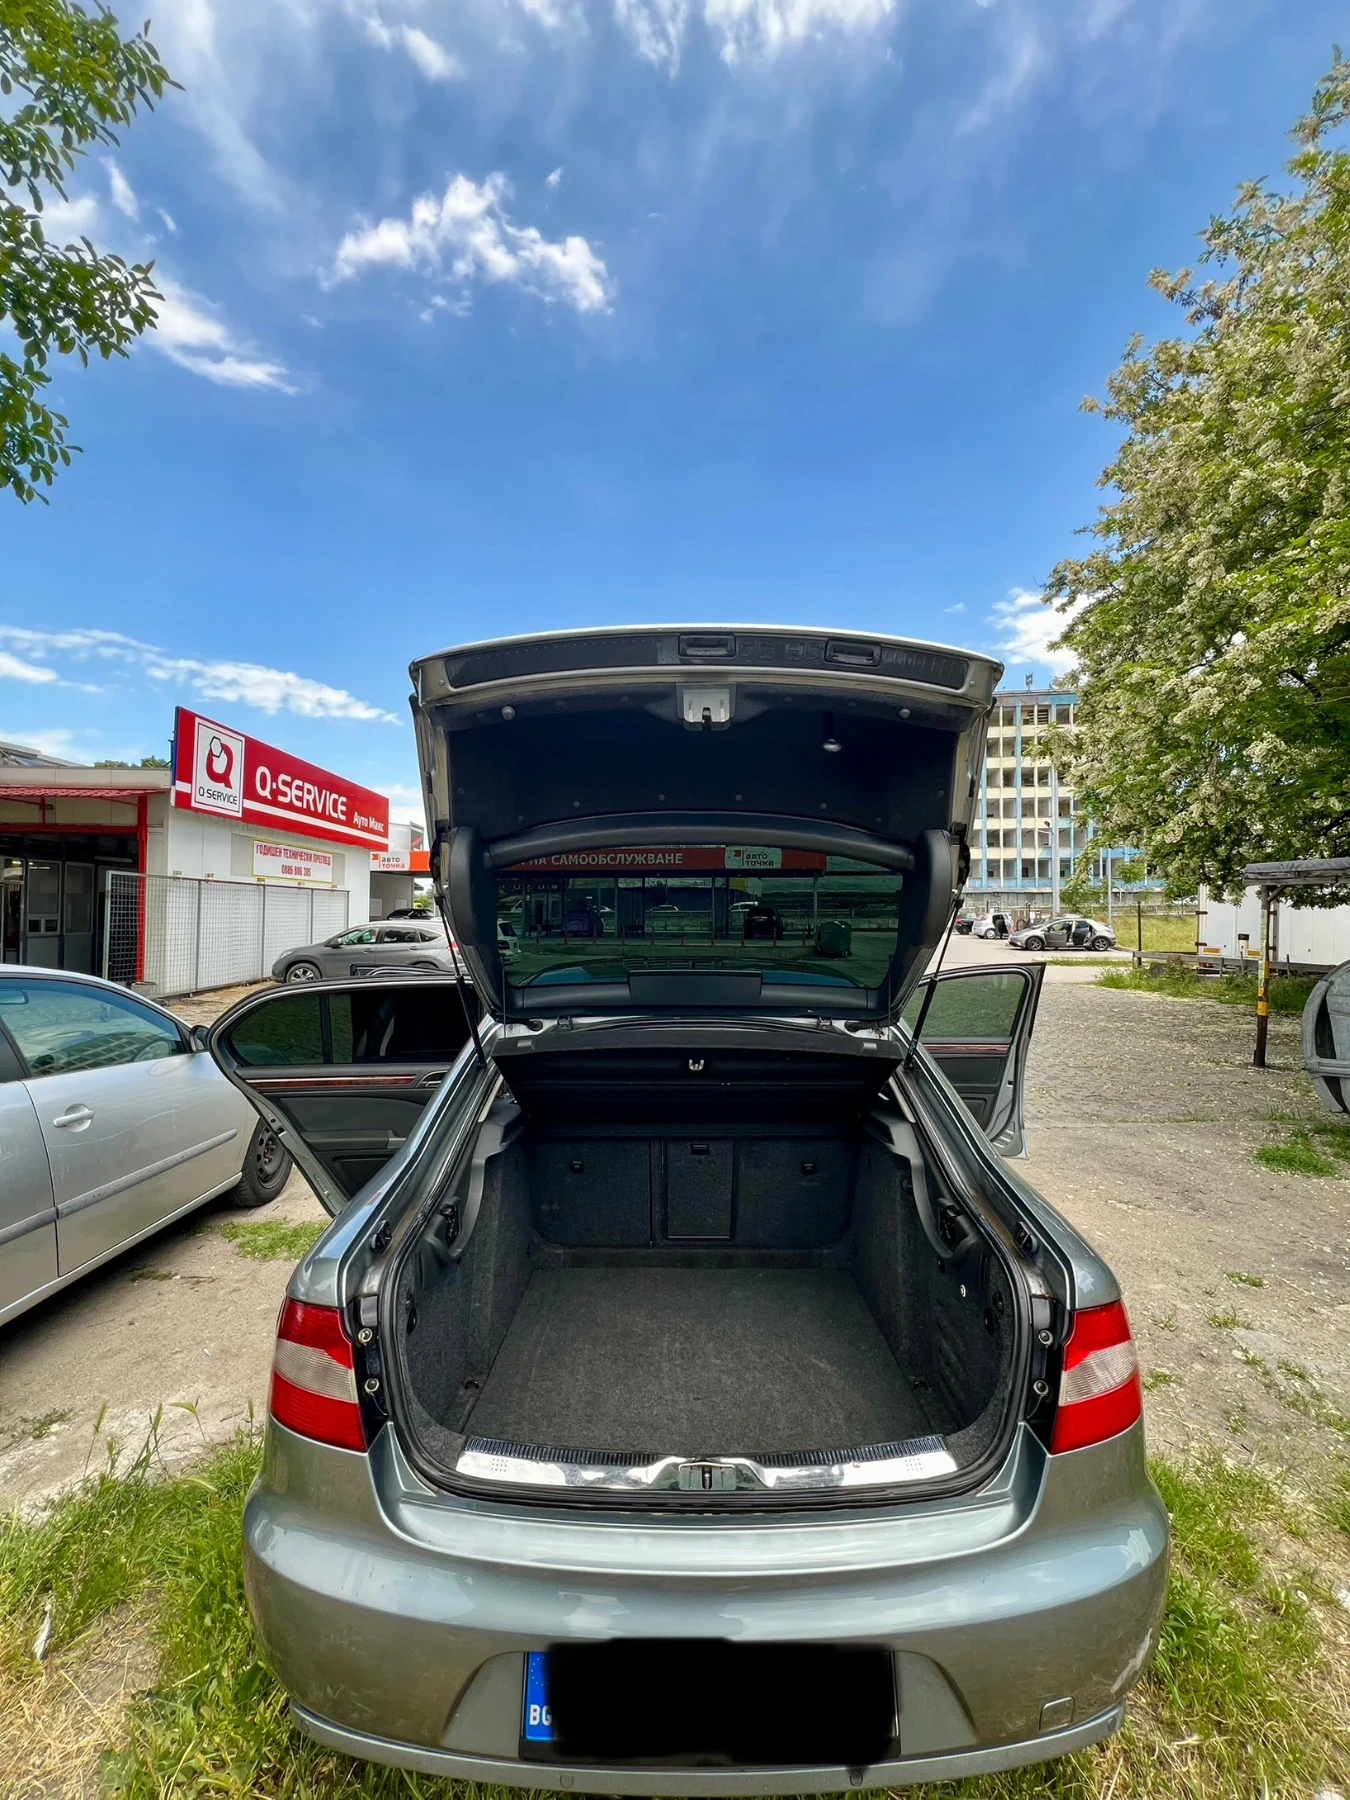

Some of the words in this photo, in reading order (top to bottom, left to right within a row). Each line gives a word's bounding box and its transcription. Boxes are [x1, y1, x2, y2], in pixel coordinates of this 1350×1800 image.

[353, 811, 368, 828] Ауто
[369, 817, 384, 832] Макс
[256, 844, 282, 857] ГОДИШЕН
[283, 848, 312, 862] ТЕХНИЧЕСКИ
[551, 853, 683, 866] САМООБСЛУЖВАНЕ
[529, 1704, 552, 1726] BG
